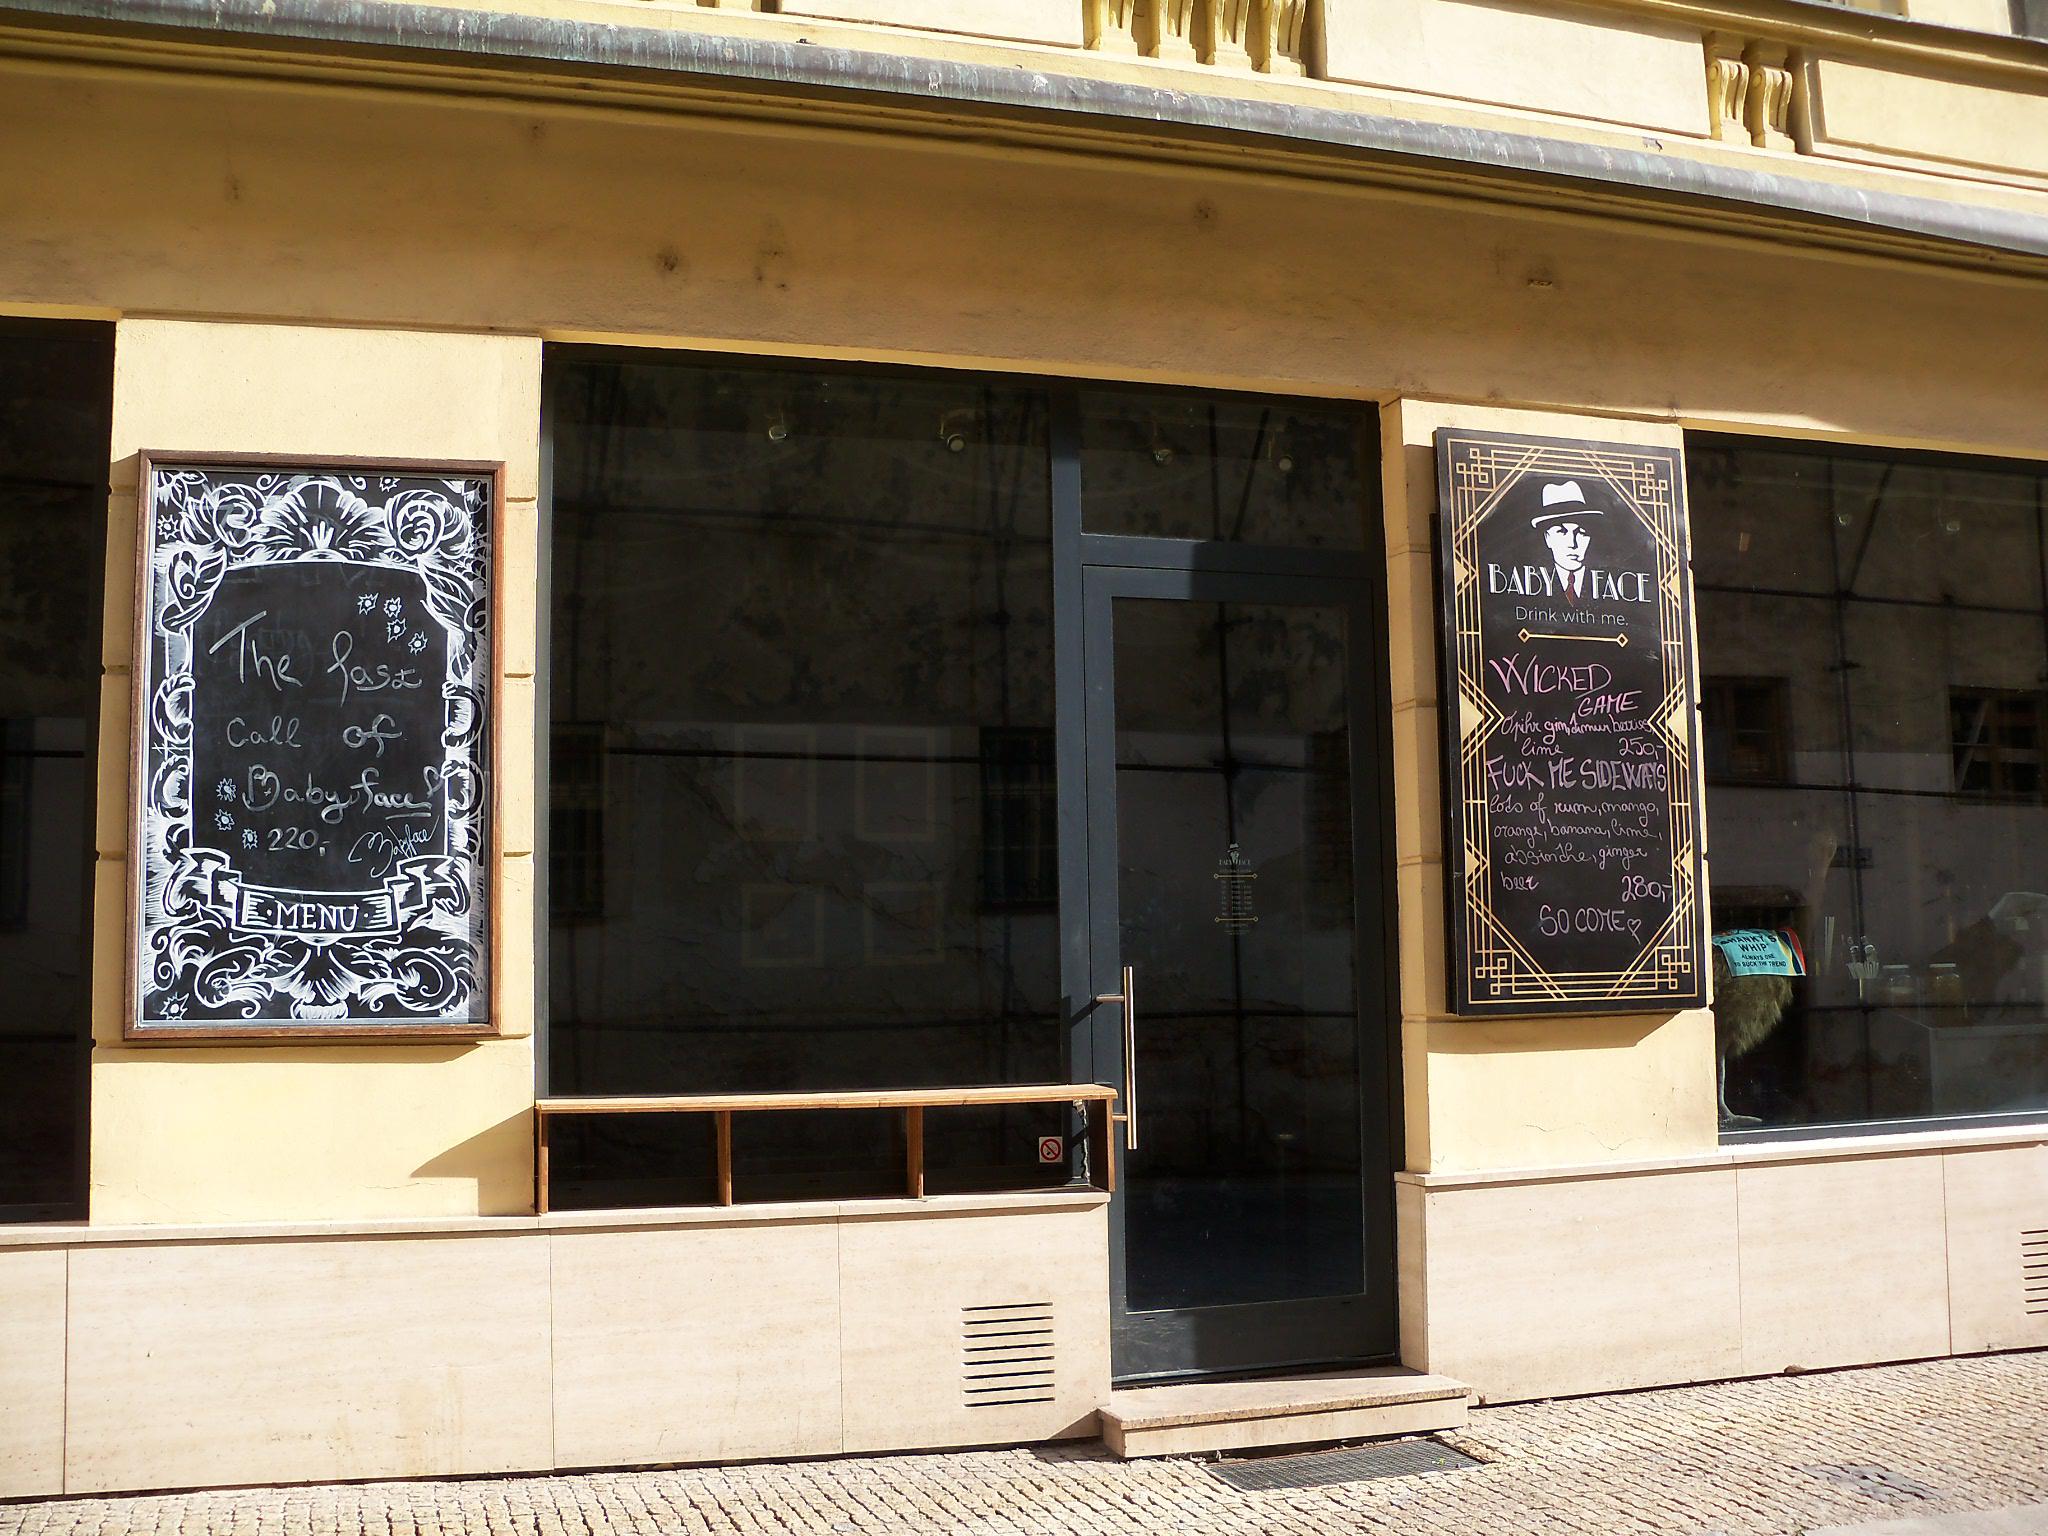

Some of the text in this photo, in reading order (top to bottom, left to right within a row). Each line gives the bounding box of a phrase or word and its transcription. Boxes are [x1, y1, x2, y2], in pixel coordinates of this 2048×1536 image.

[1487, 563, 1652, 603] BABY FACE
[1515, 606, 1629, 627] Drink with me.
[209, 610, 303, 692] The
[1488, 653, 1612, 699] WICKED
[1578, 690, 1642, 717] GAME
[226, 713, 403, 758] Call of
[1521, 737, 1563, 756] lime
[1486, 754, 1667, 792] FUCK ME SIDEWAYS
[1529, 792, 1547, 824] of
[1599, 846, 1648, 871] ginger
[1500, 871, 1539, 891] beer
[273, 902, 360, 932] MENU
[1539, 904, 1626, 936] SO COME
[1719, 934, 1778, 945] HANKYS
[1737, 943, 1766, 952] WHIP
